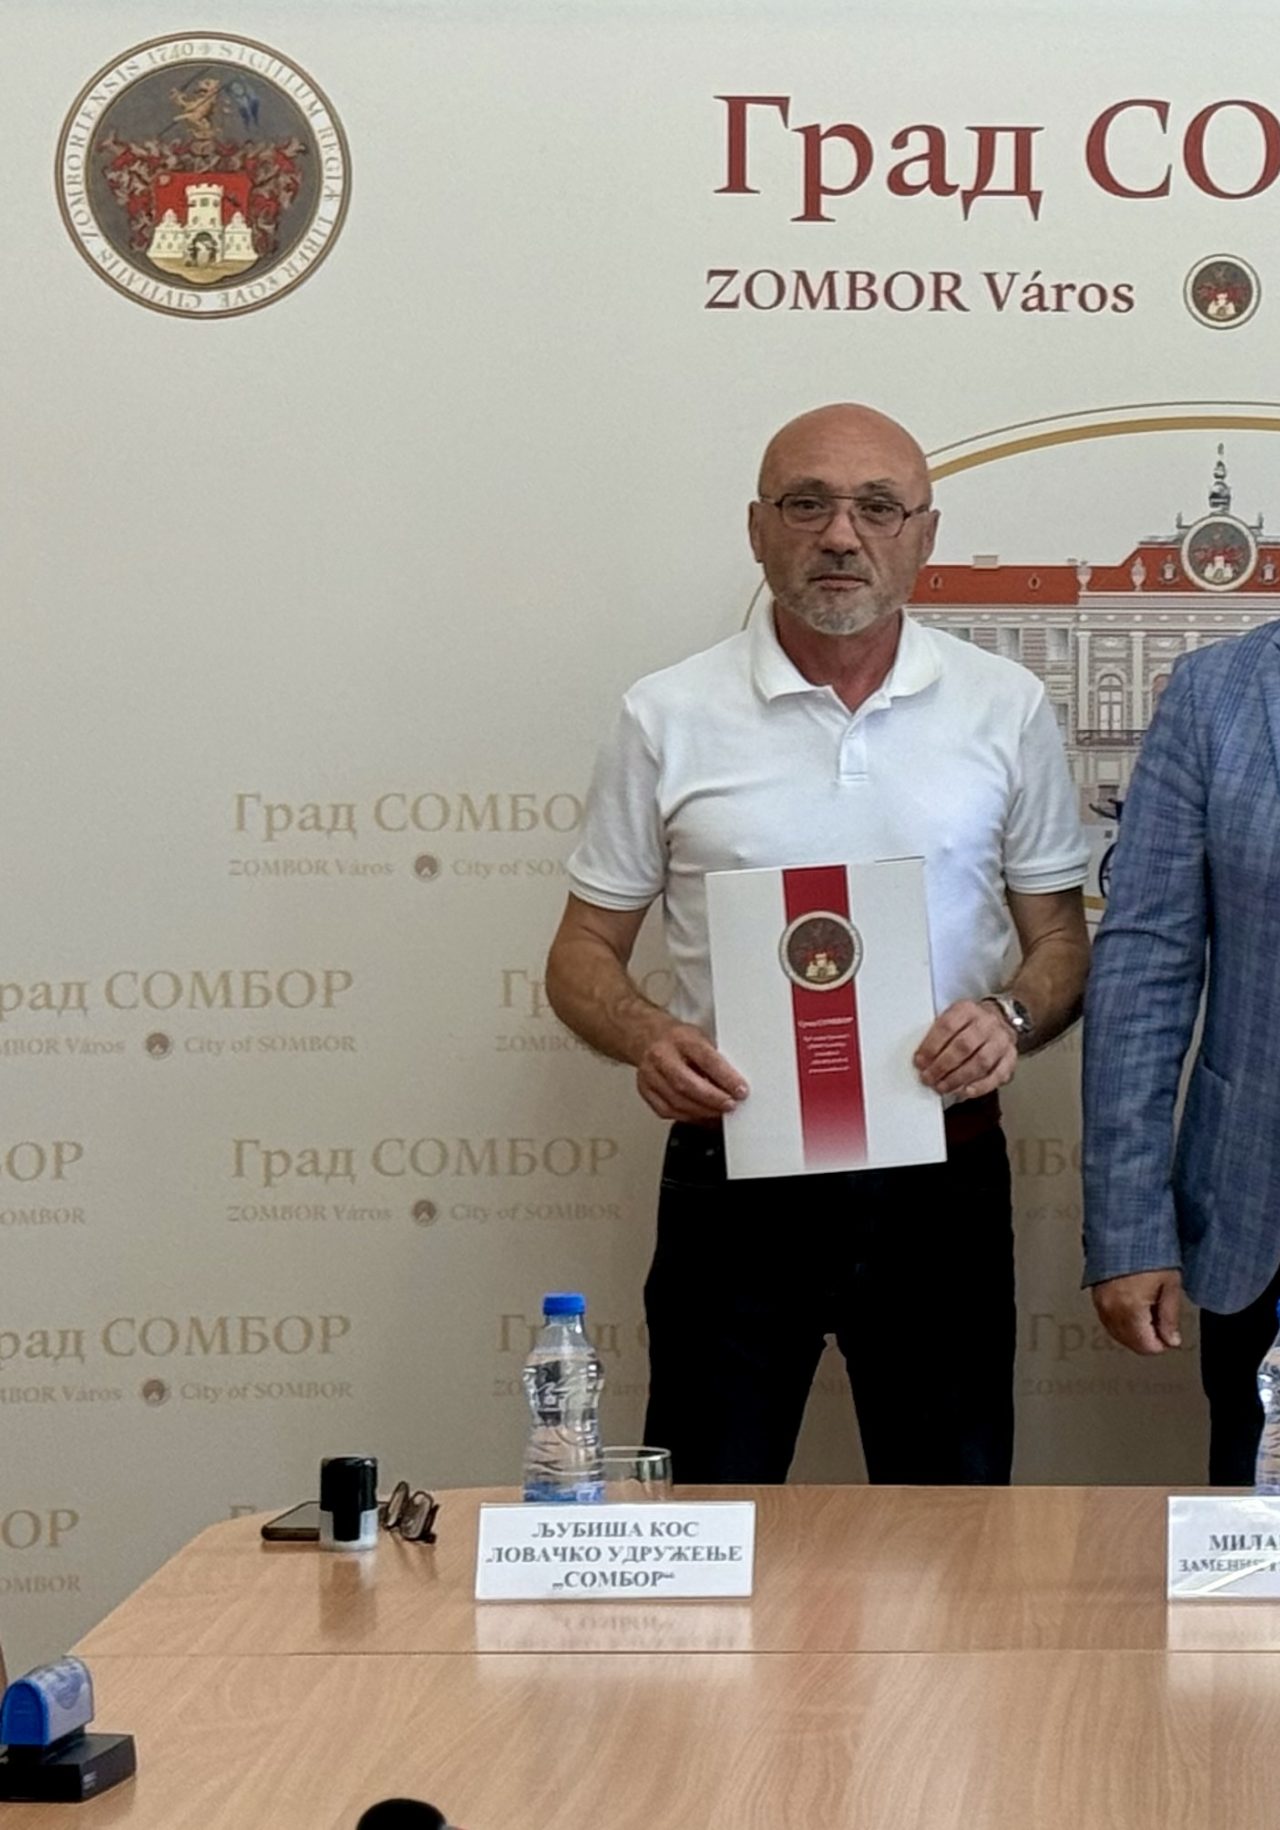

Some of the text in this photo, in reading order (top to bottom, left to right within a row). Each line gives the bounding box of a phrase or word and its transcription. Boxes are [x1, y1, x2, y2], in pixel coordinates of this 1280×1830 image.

[713, 95, 1044, 222] Град
[704, 269, 1135, 313] ZOMBOR Város
[233, 792, 584, 842] Град СОМБО
[228, 859, 329, 877] ZOMBOR
[452, 858, 494, 880] City
[499, 858, 521, 877] of
[0, 969, 354, 1021] рад СОМБОР
[184, 1035, 357, 1057] City of SOMBOR
[232, 1137, 619, 1187] Град СОМБОР
[0, 1206, 86, 1226] OMBOR
[227, 1204, 327, 1223] ZOMBOR
[450, 1203, 622, 1225] City of SOMBOR
[0, 1315, 351, 1371] рад СОМБОР
[180, 1381, 353, 1404] City of SOMBOR
[532, 1520, 700, 1539] ЉУБИША КОС
[485, 1545, 743, 1564] ЛОВАЧКО УДРУЖЕЊЕ
